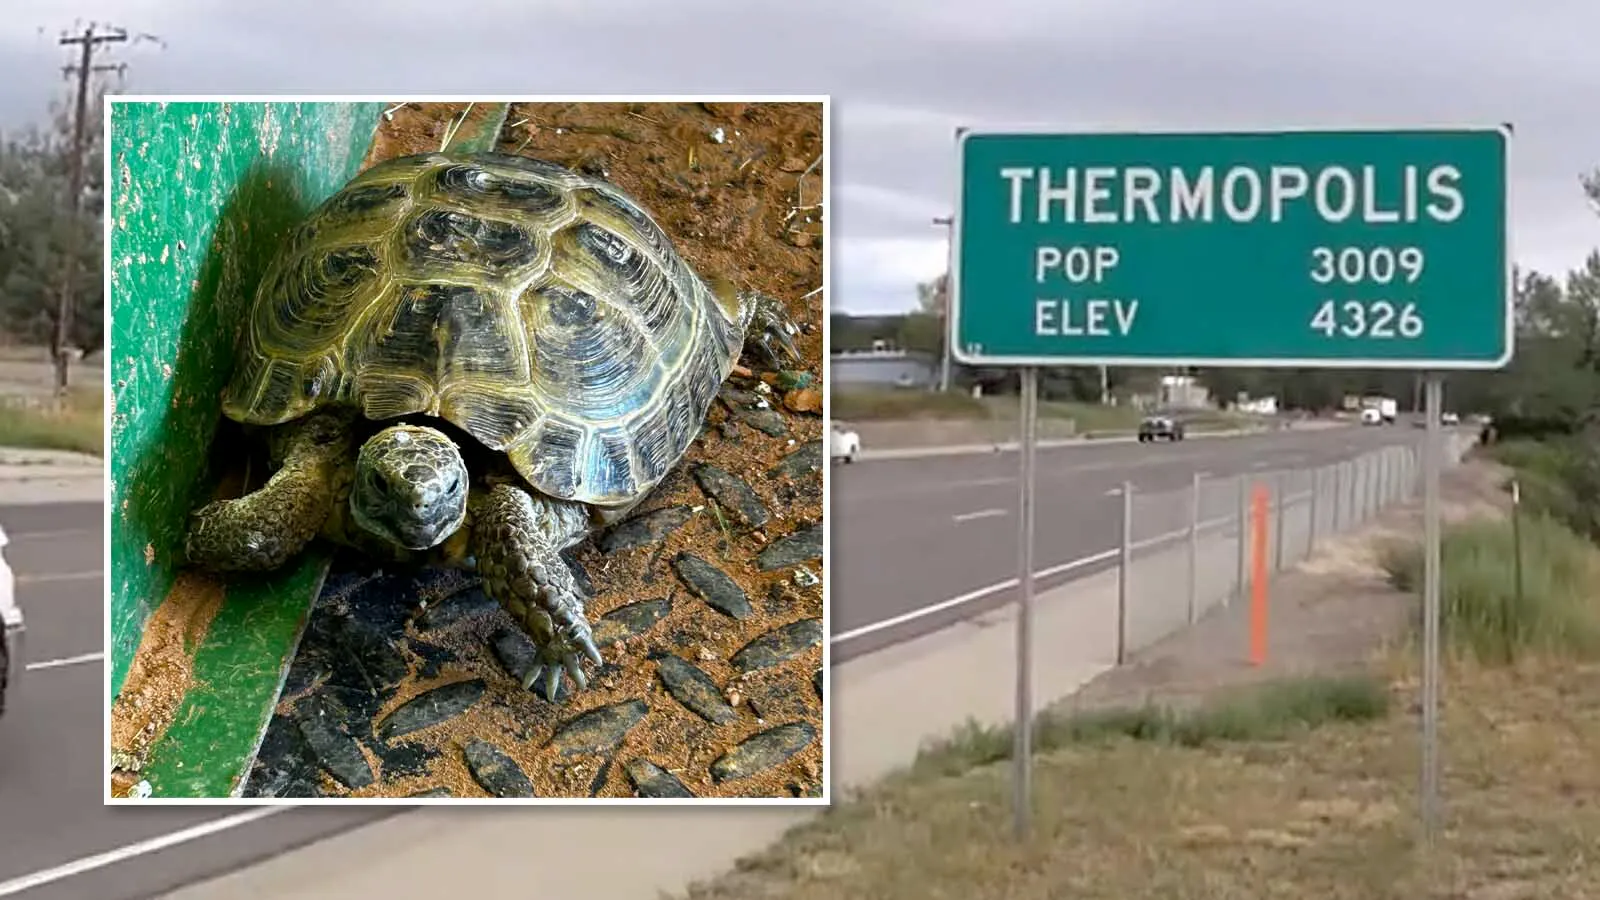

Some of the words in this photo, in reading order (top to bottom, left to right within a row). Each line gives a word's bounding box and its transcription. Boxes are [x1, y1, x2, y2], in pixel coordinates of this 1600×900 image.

[1000, 165, 1464, 223] THERMOPOLIS
[1036, 246, 1119, 282] POP
[1310, 246, 1424, 283] 3009
[1035, 300, 1138, 335] ELEV
[1310, 300, 1423, 337] 4326
